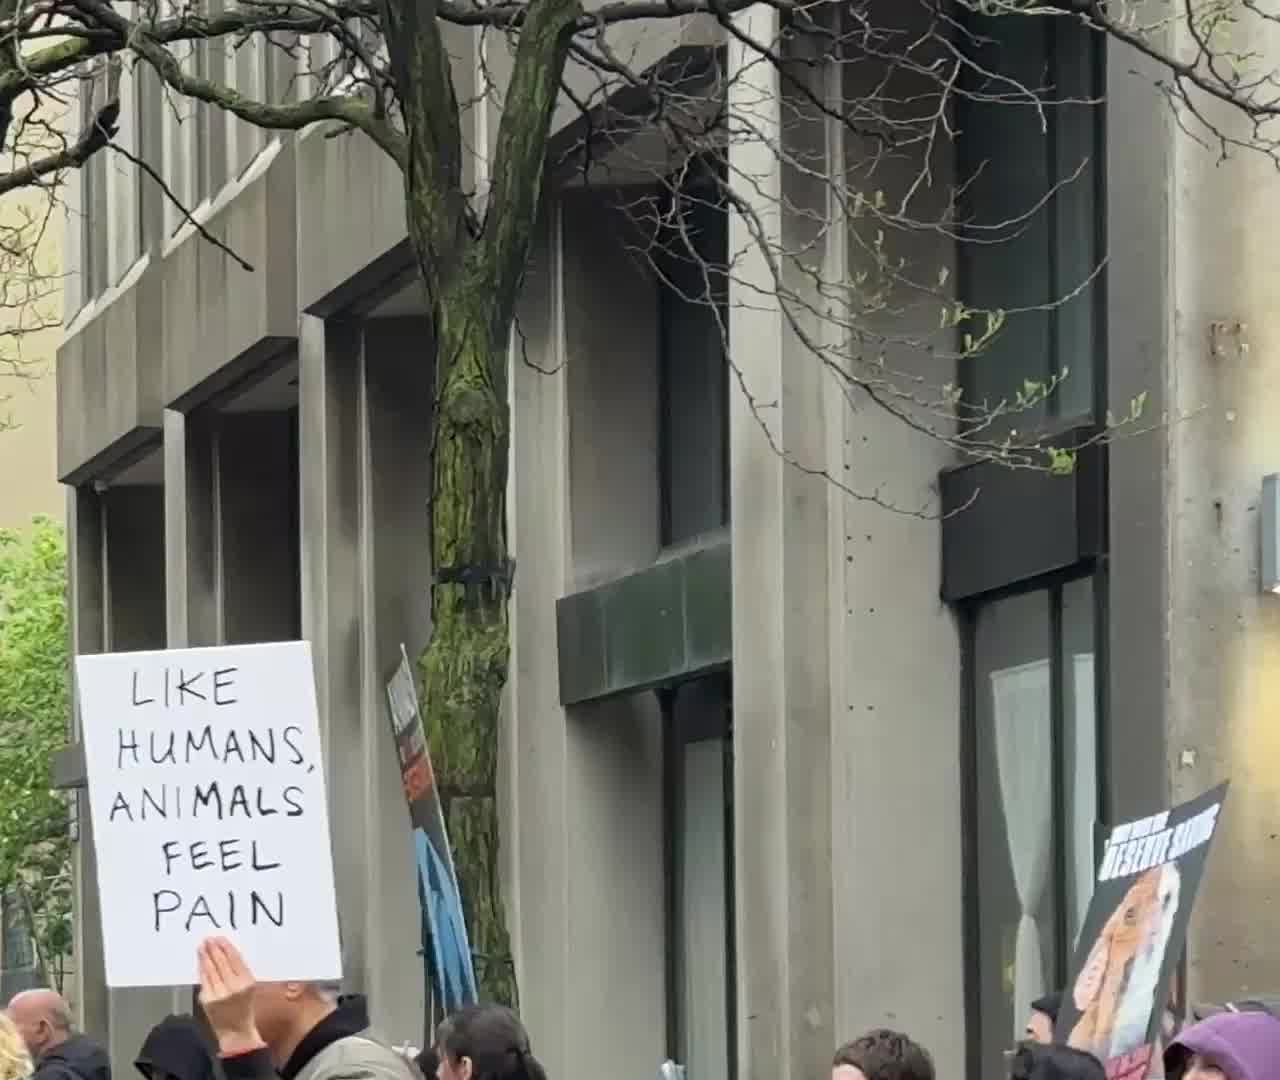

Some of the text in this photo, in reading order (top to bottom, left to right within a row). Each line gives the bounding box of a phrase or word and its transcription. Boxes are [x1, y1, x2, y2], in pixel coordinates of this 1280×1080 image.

[131, 667, 239, 708] LIKE
[118, 725, 315, 774] HUMANS,
[109, 780, 304, 821] ANIMALS
[162, 840, 281, 876] FEEL
[153, 890, 284, 932] PAIN
